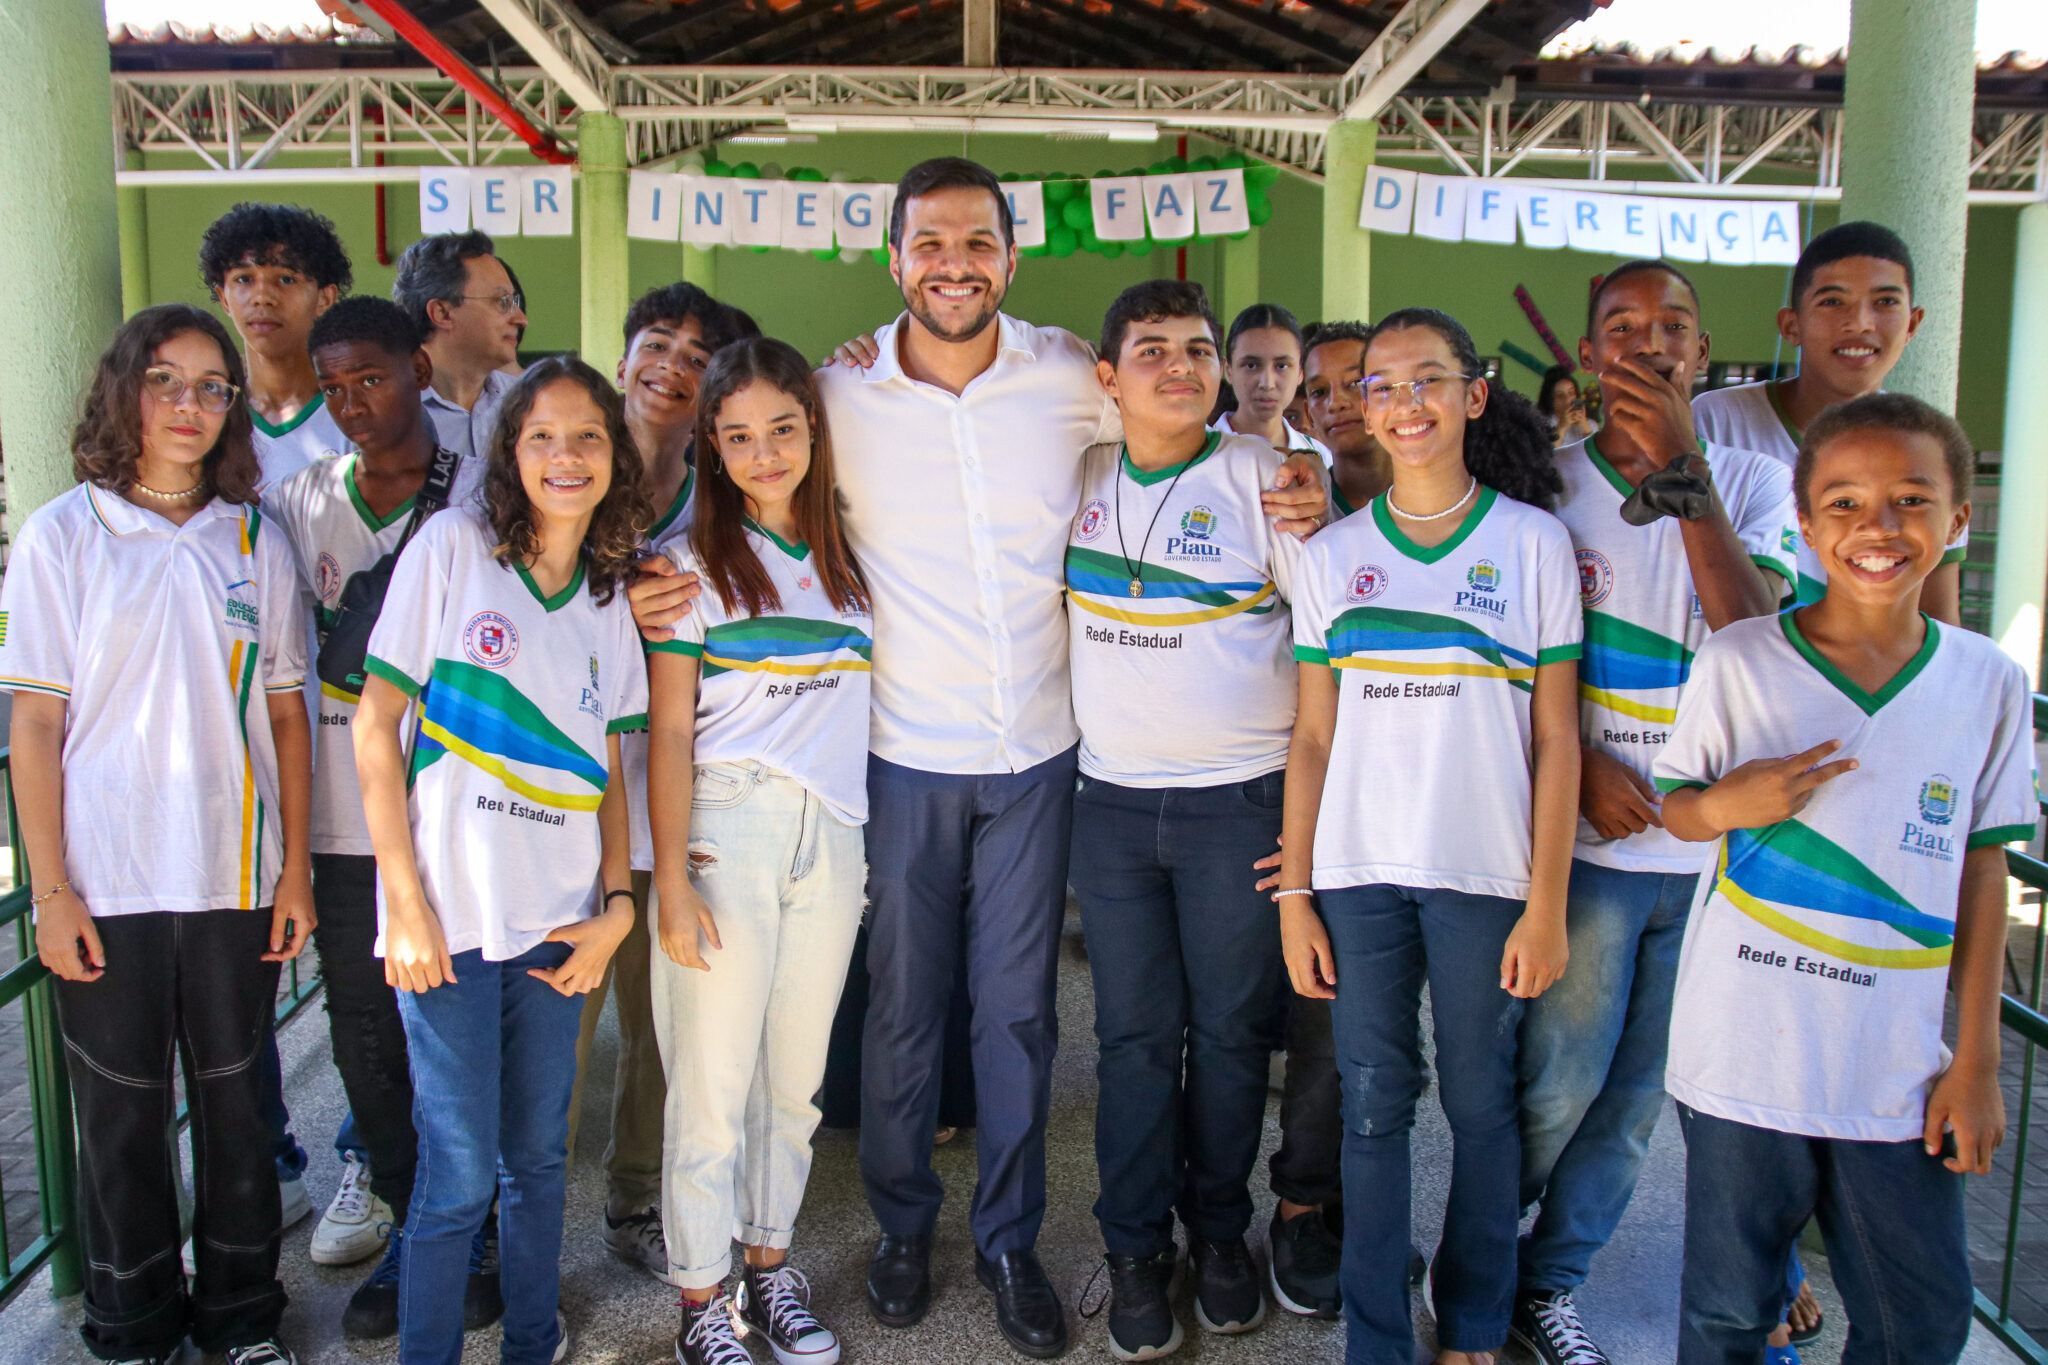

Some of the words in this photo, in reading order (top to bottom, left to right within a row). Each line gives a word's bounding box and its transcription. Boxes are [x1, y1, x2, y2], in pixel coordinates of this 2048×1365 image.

[427, 178, 559, 213] SER
[651, 187, 1028, 227] INTEGL
[1106, 178, 1232, 220] FAZ
[1373, 175, 1790, 250] DIFERENÇA
[1453, 591, 1508, 616] Piauí
[1086, 624, 1115, 644] Rede
[1119, 629, 1183, 649] Estadual
[1363, 683, 1400, 700] Rede
[1403, 681, 1462, 698] Estadual
[1603, 729, 1639, 744] Rede
[1642, 730, 1672, 745] Est
[508, 801, 566, 827] Estadual
[1901, 821, 1954, 854] Piauí
[1737, 943, 1787, 968] Rede
[1794, 955, 1877, 987] Estadual
